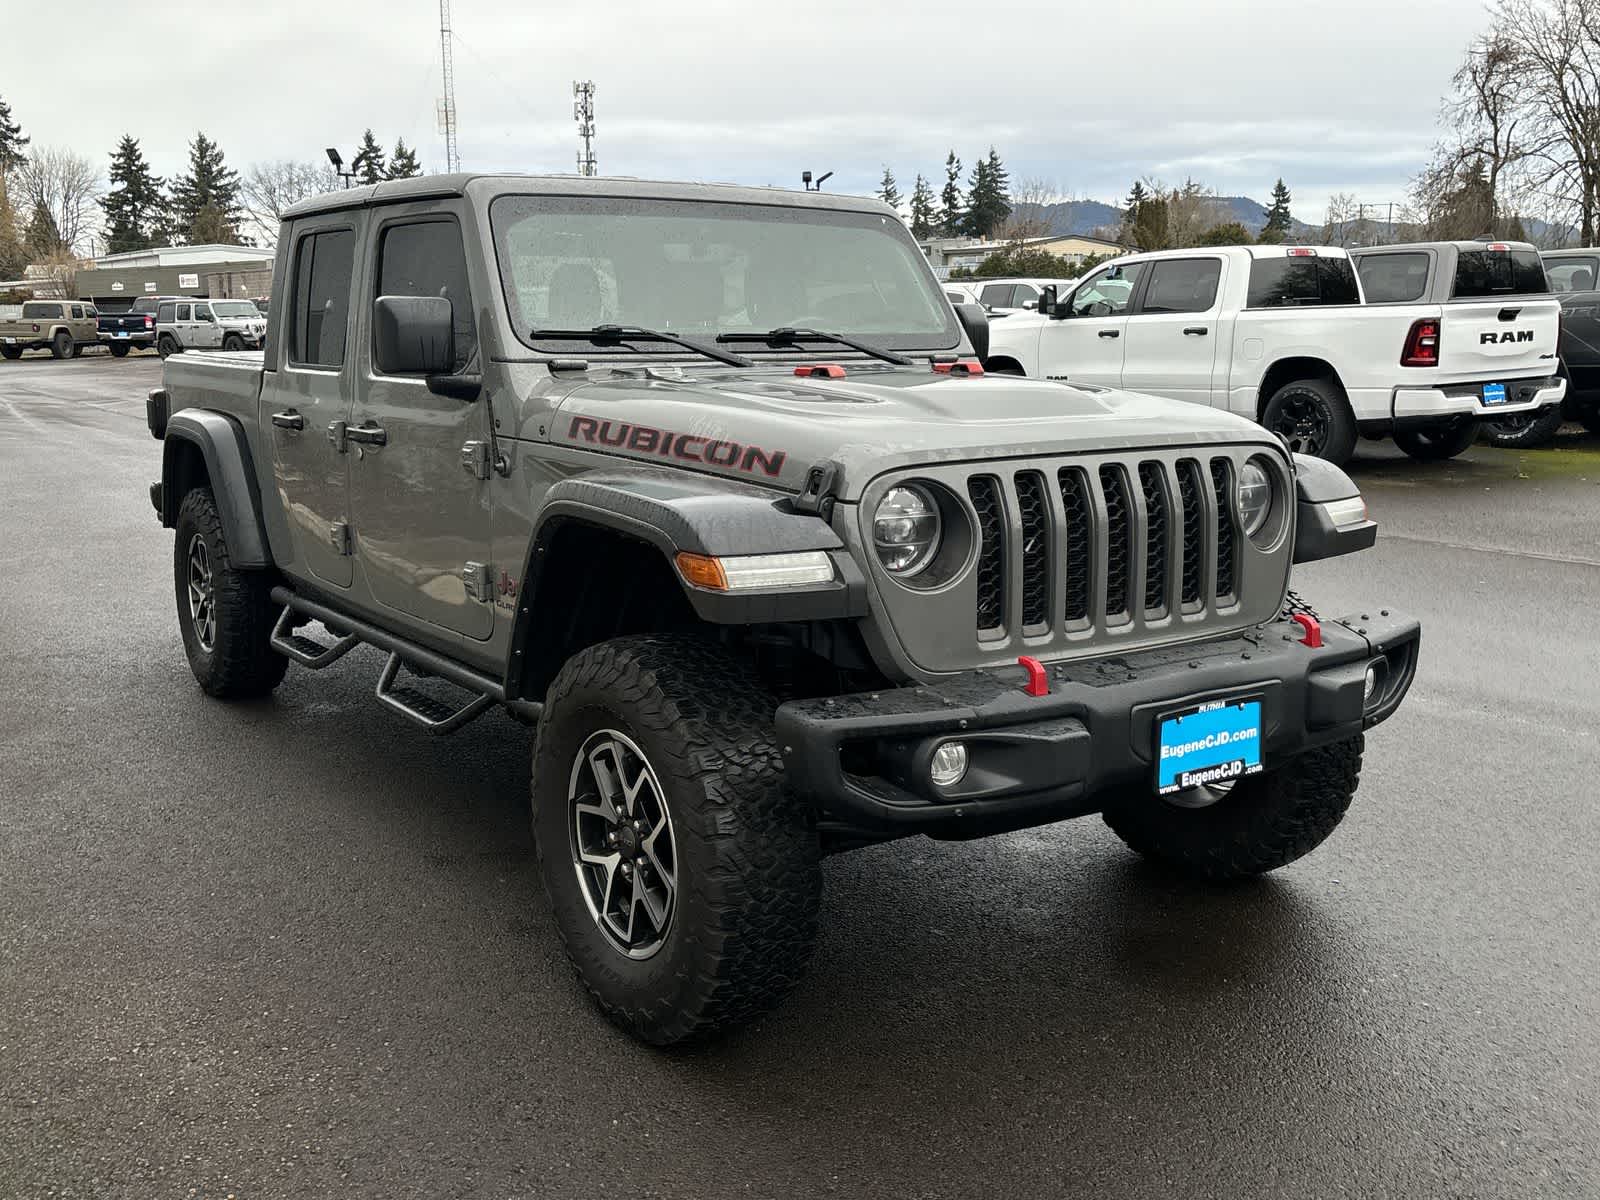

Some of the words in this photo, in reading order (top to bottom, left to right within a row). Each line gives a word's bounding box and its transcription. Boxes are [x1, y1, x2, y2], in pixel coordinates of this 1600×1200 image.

[1480, 330, 1534, 344] RAM
[567, 416, 787, 477] RUBICON
[1160, 727, 1258, 759] EugeneCJD.com
[1181, 760, 1242, 787] EugeneCJD
